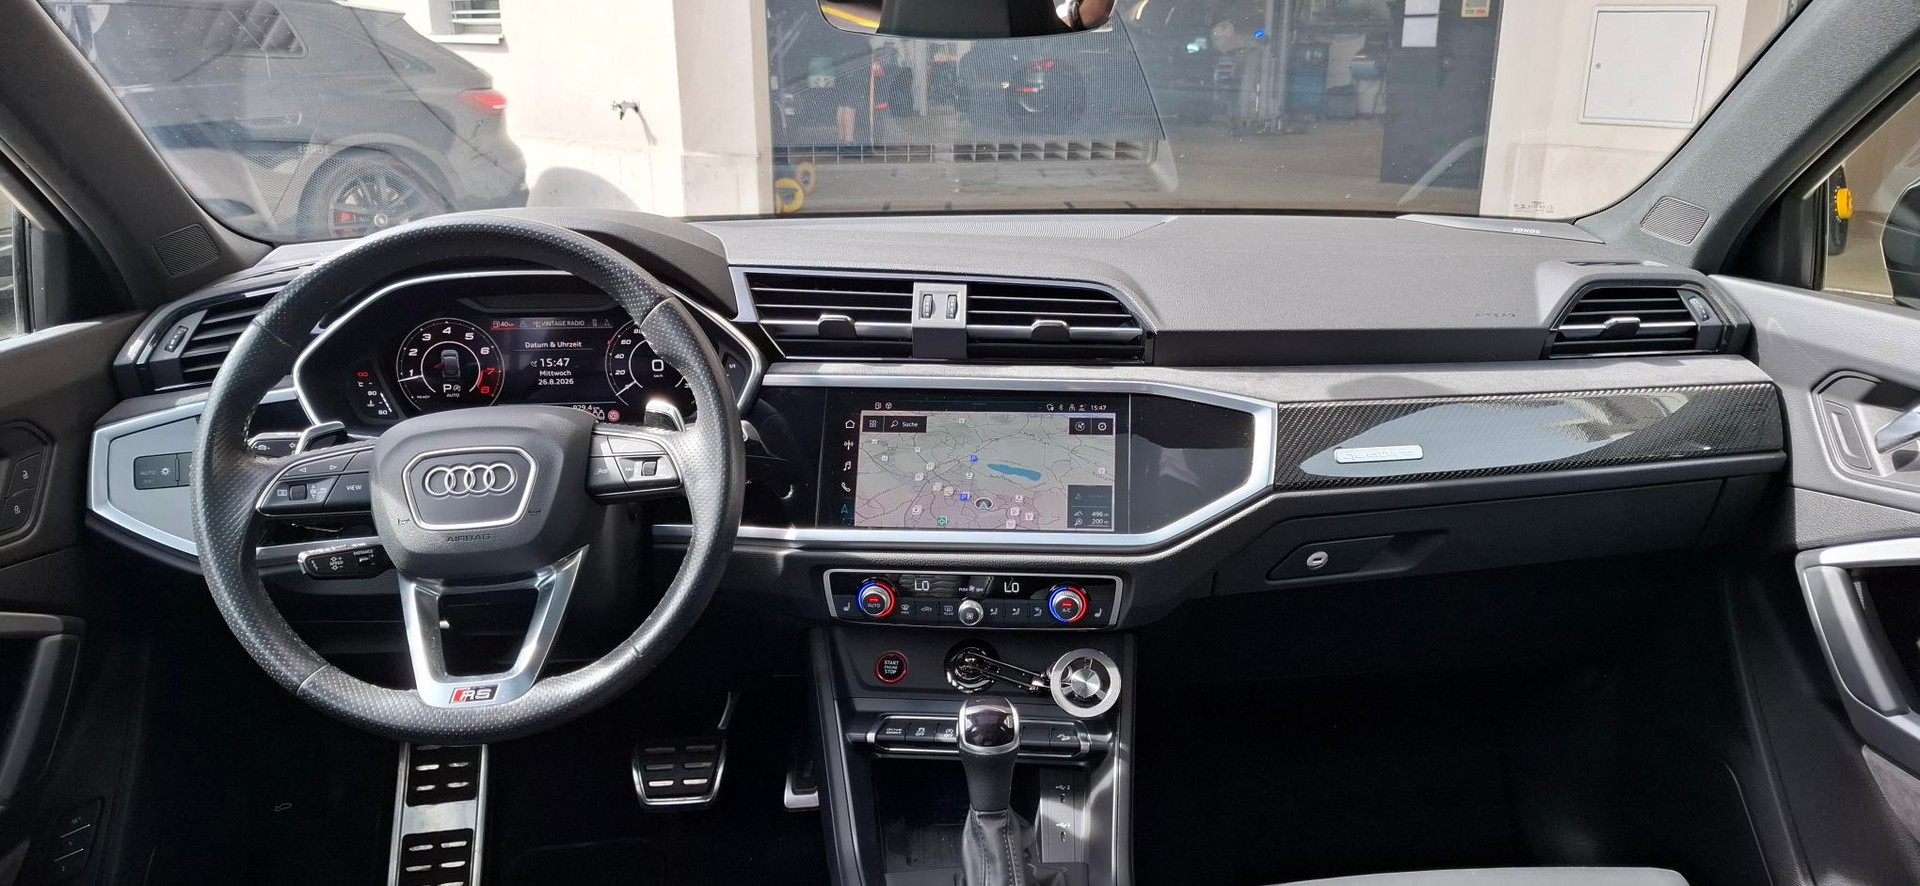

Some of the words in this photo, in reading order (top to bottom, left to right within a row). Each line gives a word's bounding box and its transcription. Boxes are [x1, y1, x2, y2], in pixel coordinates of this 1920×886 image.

[442, 326, 451, 335] 4
[421, 333, 431, 341] 3
[464, 332, 474, 341] 5
[408, 348, 418, 356] 2
[480, 347, 490, 355] 6
[539, 357, 570, 367] 15:47
[651, 359, 664, 372] 0
[486, 367, 495, 375] 7
[443, 384, 452, 393] P
[480, 386, 490, 394] 8
[446, 533, 491, 542] AIRBAG
[914, 580, 930, 591] LO
[1004, 582, 1020, 593] LO
